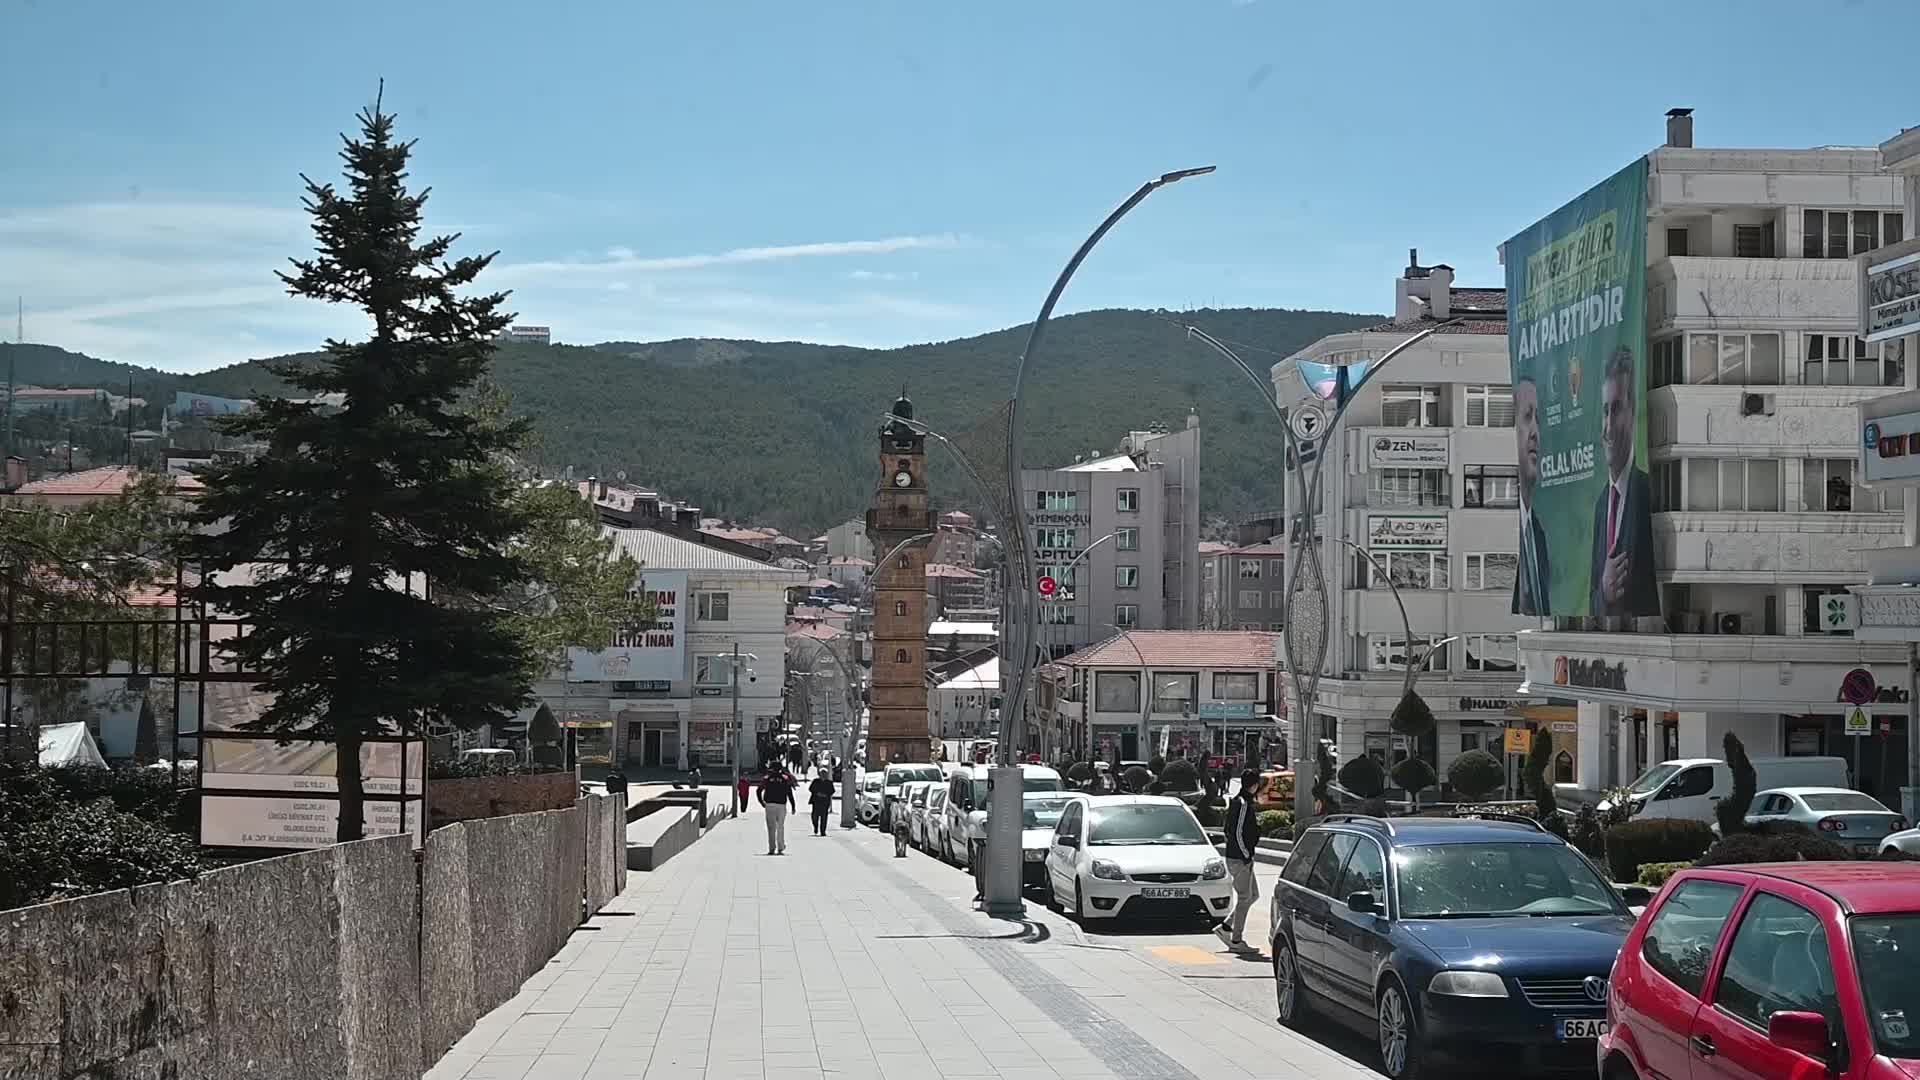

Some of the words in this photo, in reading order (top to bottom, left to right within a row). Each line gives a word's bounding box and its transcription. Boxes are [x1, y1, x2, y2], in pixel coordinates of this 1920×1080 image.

[1519, 320, 1539, 361] AK
[1541, 451, 1570, 478] CELAL
[1571, 441, 1594, 473] KÖSE
[1565, 1021, 1585, 1037] 66
